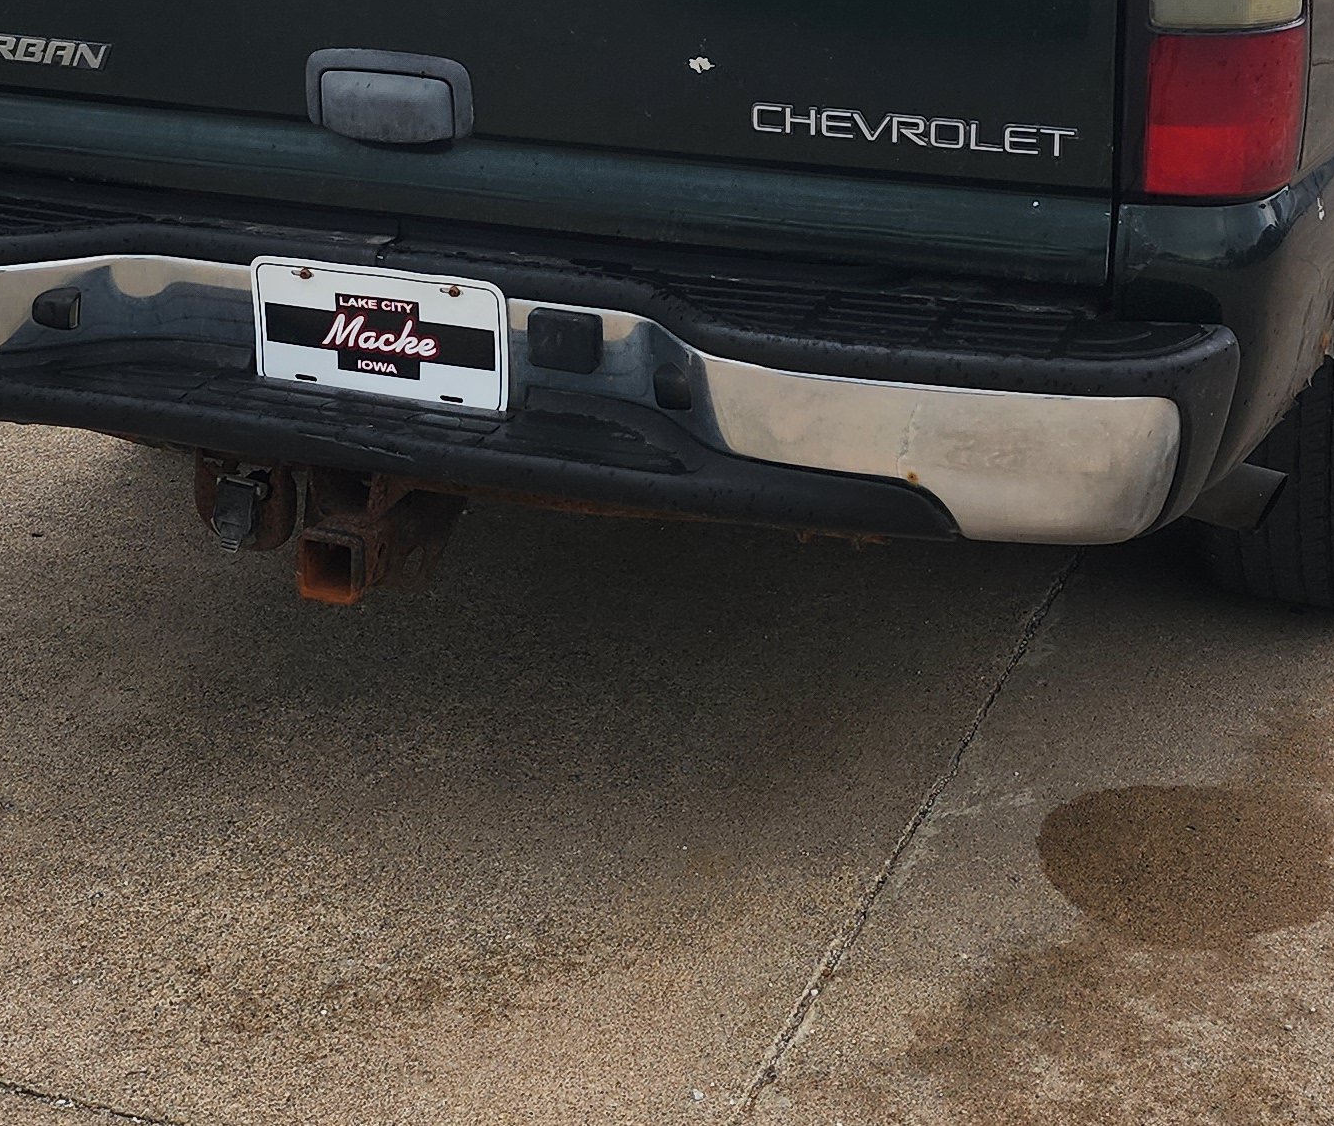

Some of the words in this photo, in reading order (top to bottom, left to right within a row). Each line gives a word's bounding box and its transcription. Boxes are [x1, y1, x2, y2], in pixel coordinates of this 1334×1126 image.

[751, 102, 1077, 158] CHEVROLET
[339, 296, 378, 310] LAKE
[381, 300, 414, 314] CITY
[322, 313, 437, 357] Macke
[357, 359, 398, 375] IOWA
